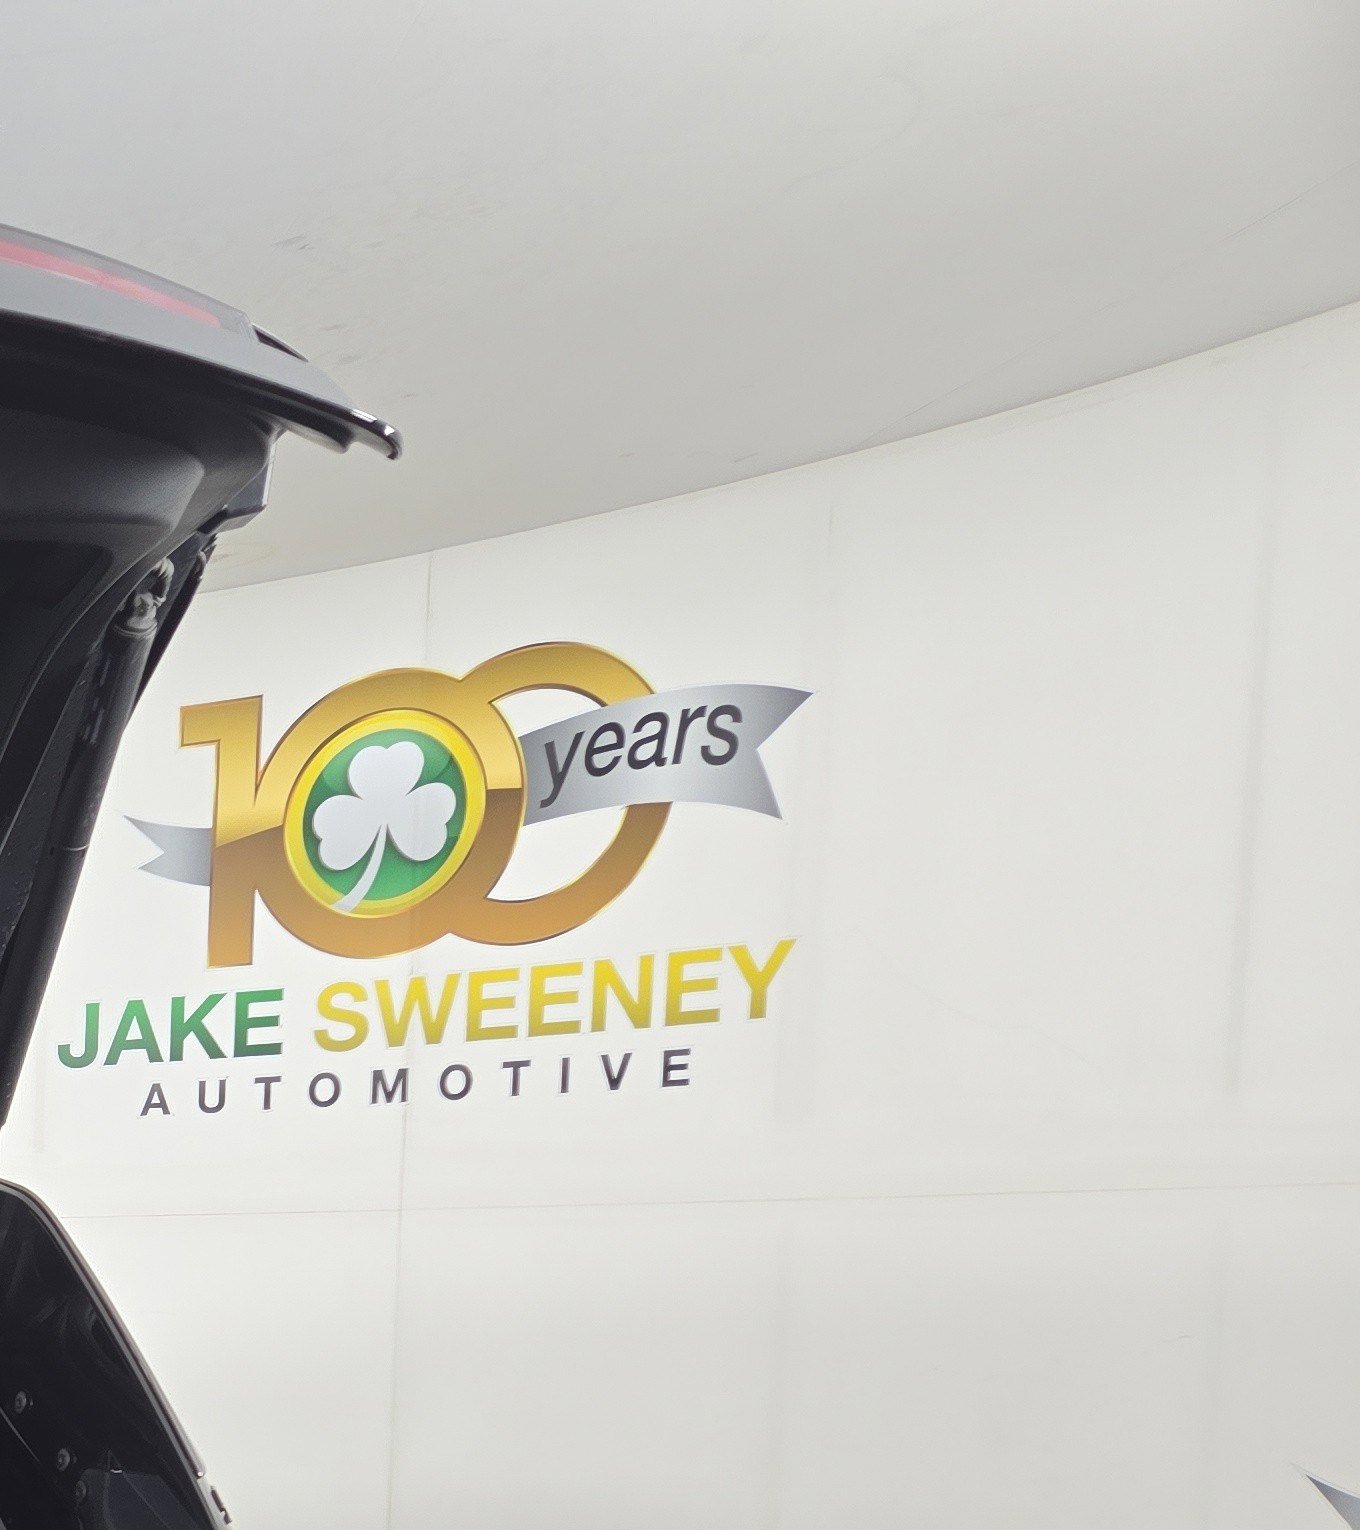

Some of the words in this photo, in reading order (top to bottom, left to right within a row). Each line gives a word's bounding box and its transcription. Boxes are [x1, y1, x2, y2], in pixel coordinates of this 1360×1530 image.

[180, 641, 673, 969] 100
[539, 703, 743, 806] years
[57, 987, 284, 1069] JAKE
[314, 938, 797, 1053] SWEENEY
[140, 1047, 692, 1117] AUTOMOTIVE
